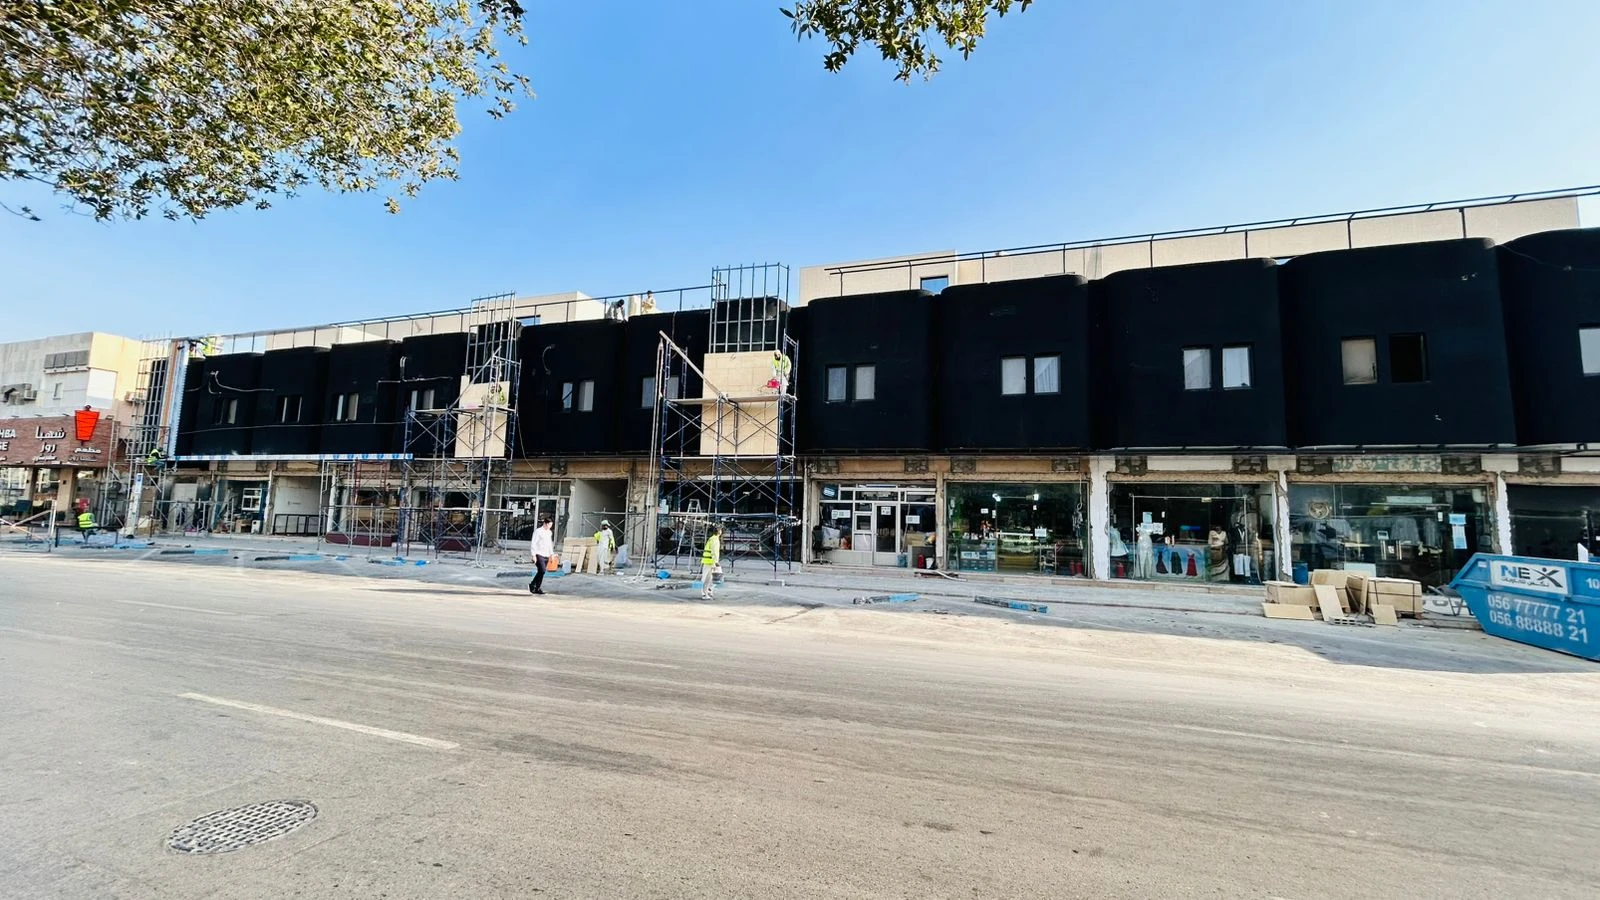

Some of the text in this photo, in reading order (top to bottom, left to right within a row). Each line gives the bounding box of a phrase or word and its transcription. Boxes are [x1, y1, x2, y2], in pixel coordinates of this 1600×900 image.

[74, 446, 101, 454] مطعم
[1501, 565, 1563, 588] NEX
[1488, 594, 1586, 624] 056 77777 21
[1489, 610, 1588, 644] 056 88888 21
